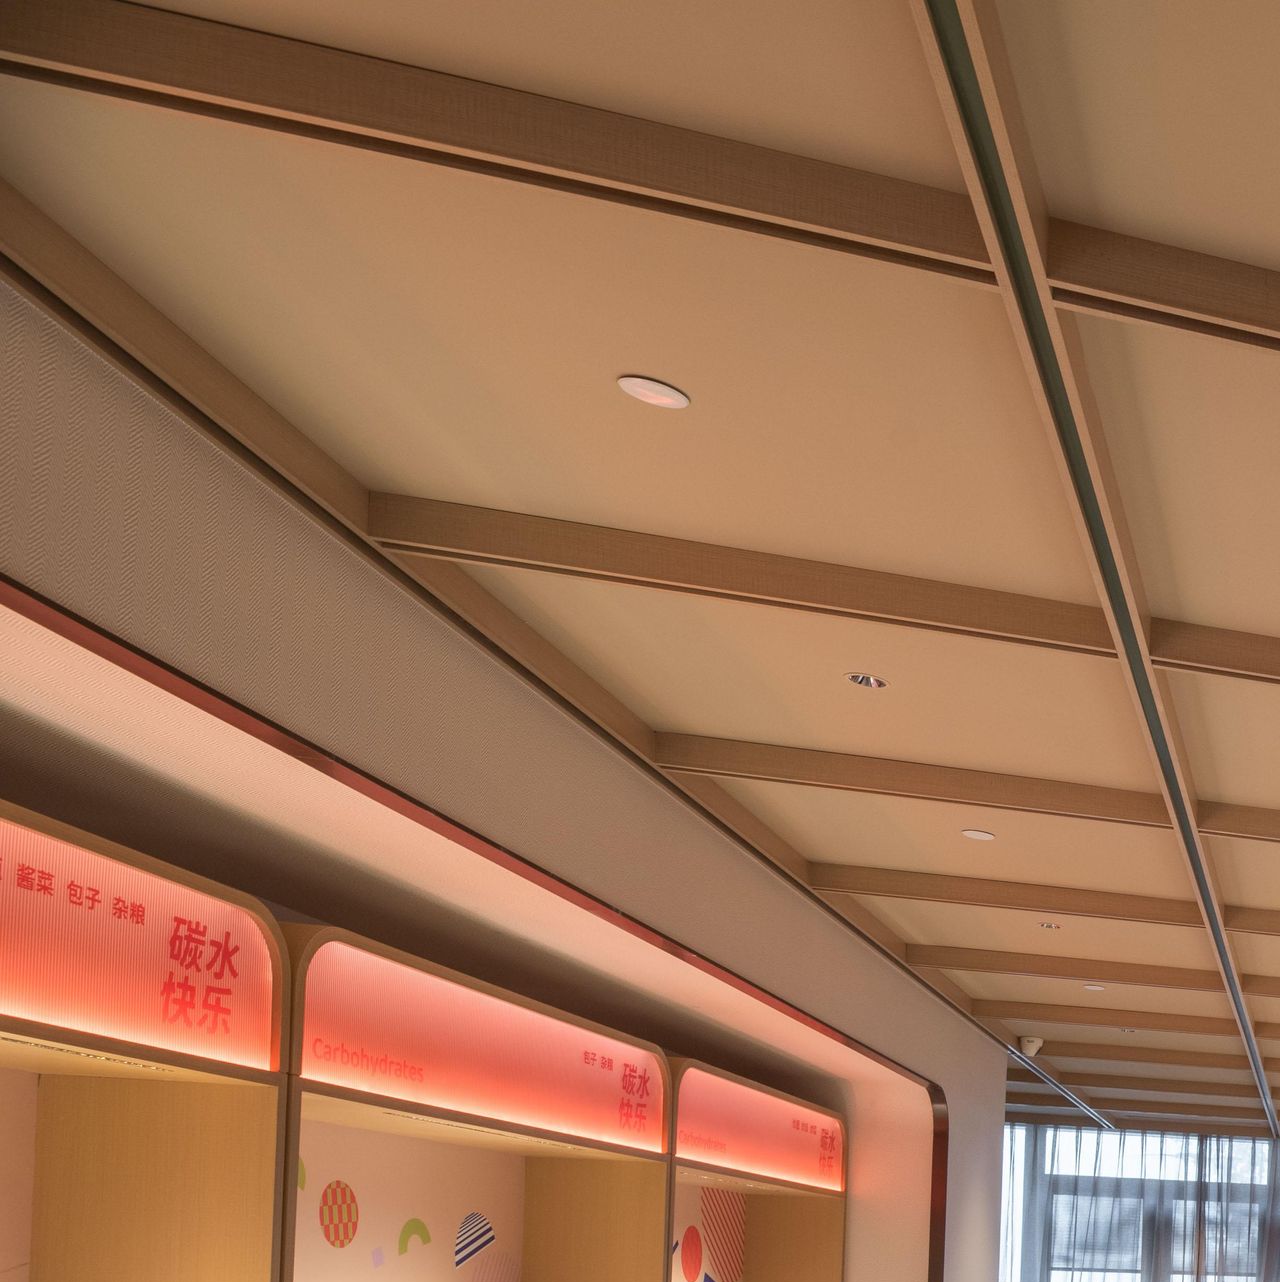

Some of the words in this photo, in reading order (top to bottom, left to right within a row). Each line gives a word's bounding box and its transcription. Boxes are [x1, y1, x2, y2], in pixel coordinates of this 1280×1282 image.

[16, 863, 55, 897] 酱菜
[67, 880, 102, 910] 包子
[112, 896, 146, 926] 杂粮
[169, 916, 240, 980] 碳水
[160, 971, 233, 1034] 快乐
[312, 1038, 424, 1082] Carbohydrates
[622, 1063, 650, 1099] 碳水
[619, 1097, 647, 1132] 快乐
